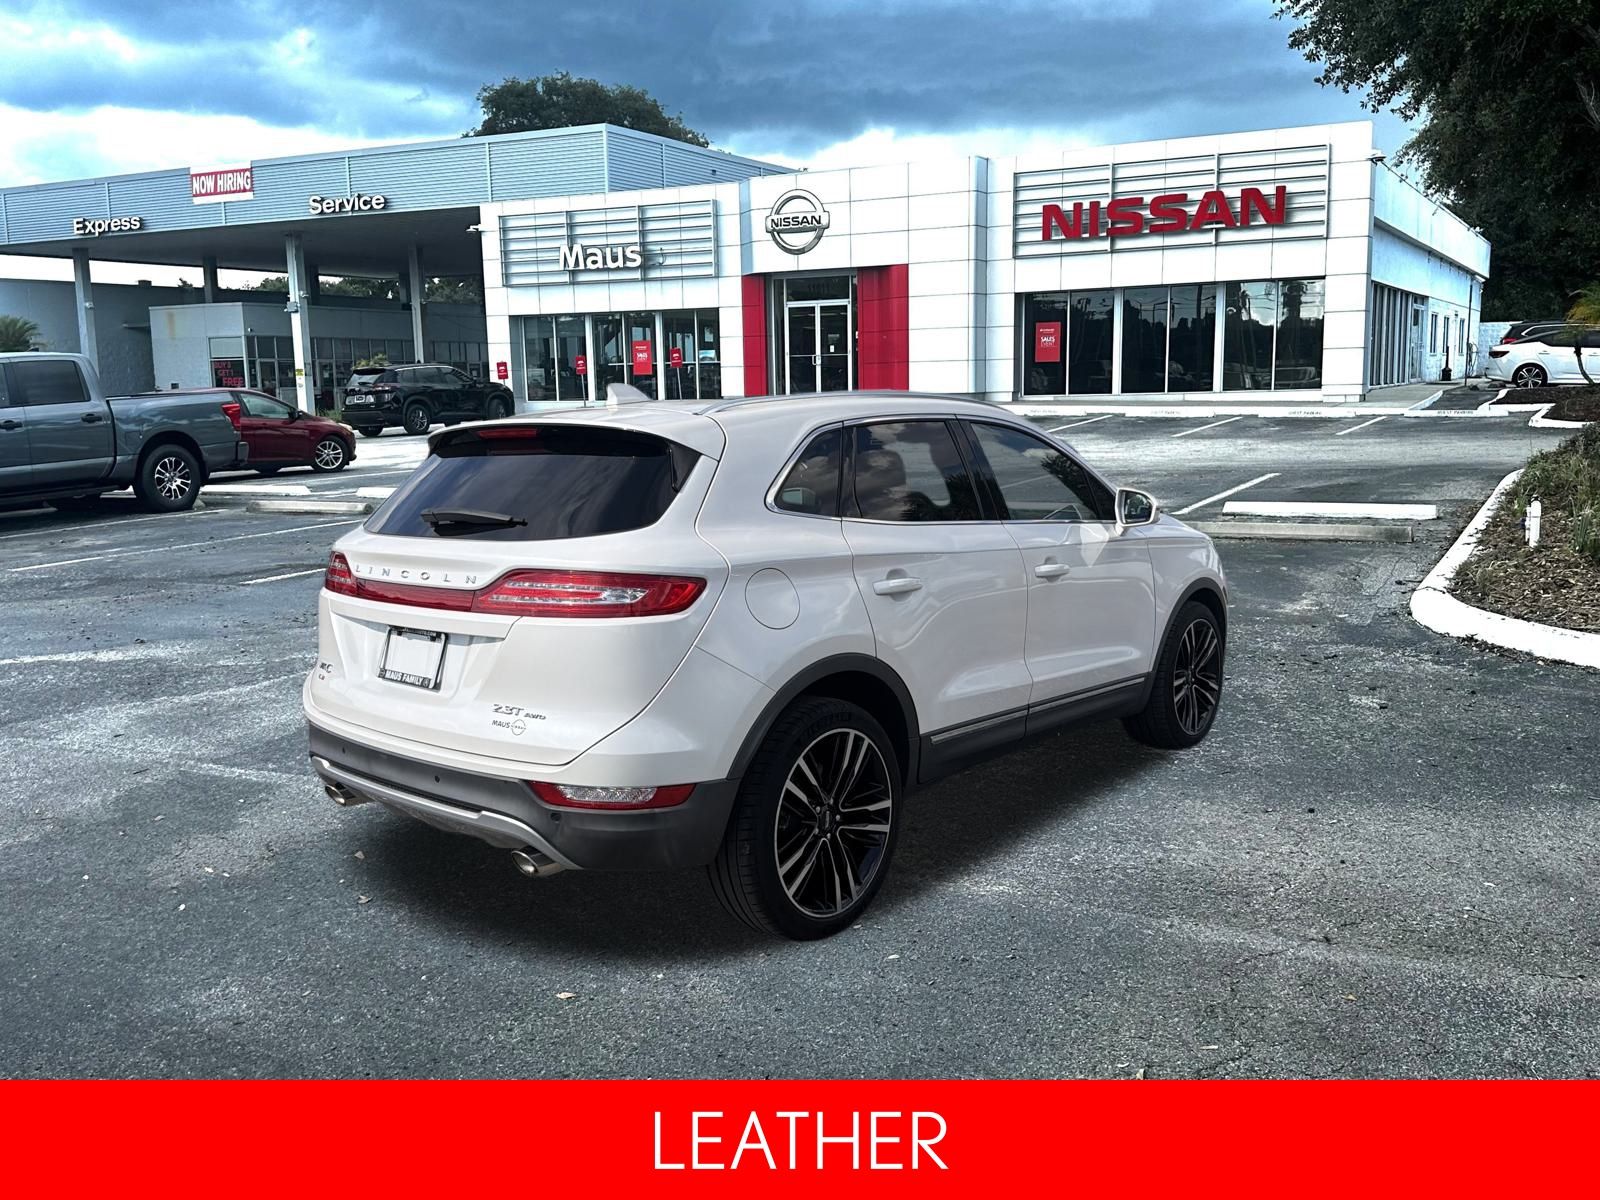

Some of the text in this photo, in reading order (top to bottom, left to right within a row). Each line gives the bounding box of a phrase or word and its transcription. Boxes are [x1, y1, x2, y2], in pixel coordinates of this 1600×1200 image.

[192, 171, 251, 195] NOW HIRING
[309, 192, 385, 215] Service
[1042, 185, 1287, 241] NISSAN
[73, 215, 141, 237] Express
[770, 214, 822, 230] NISSAN
[559, 243, 642, 271] Maus
[223, 377, 244, 386] FREE
[355, 564, 477, 584] LINCOLN
[385, 670, 424, 686] MAUS FAMILY
[492, 719, 511, 729] MAUS
